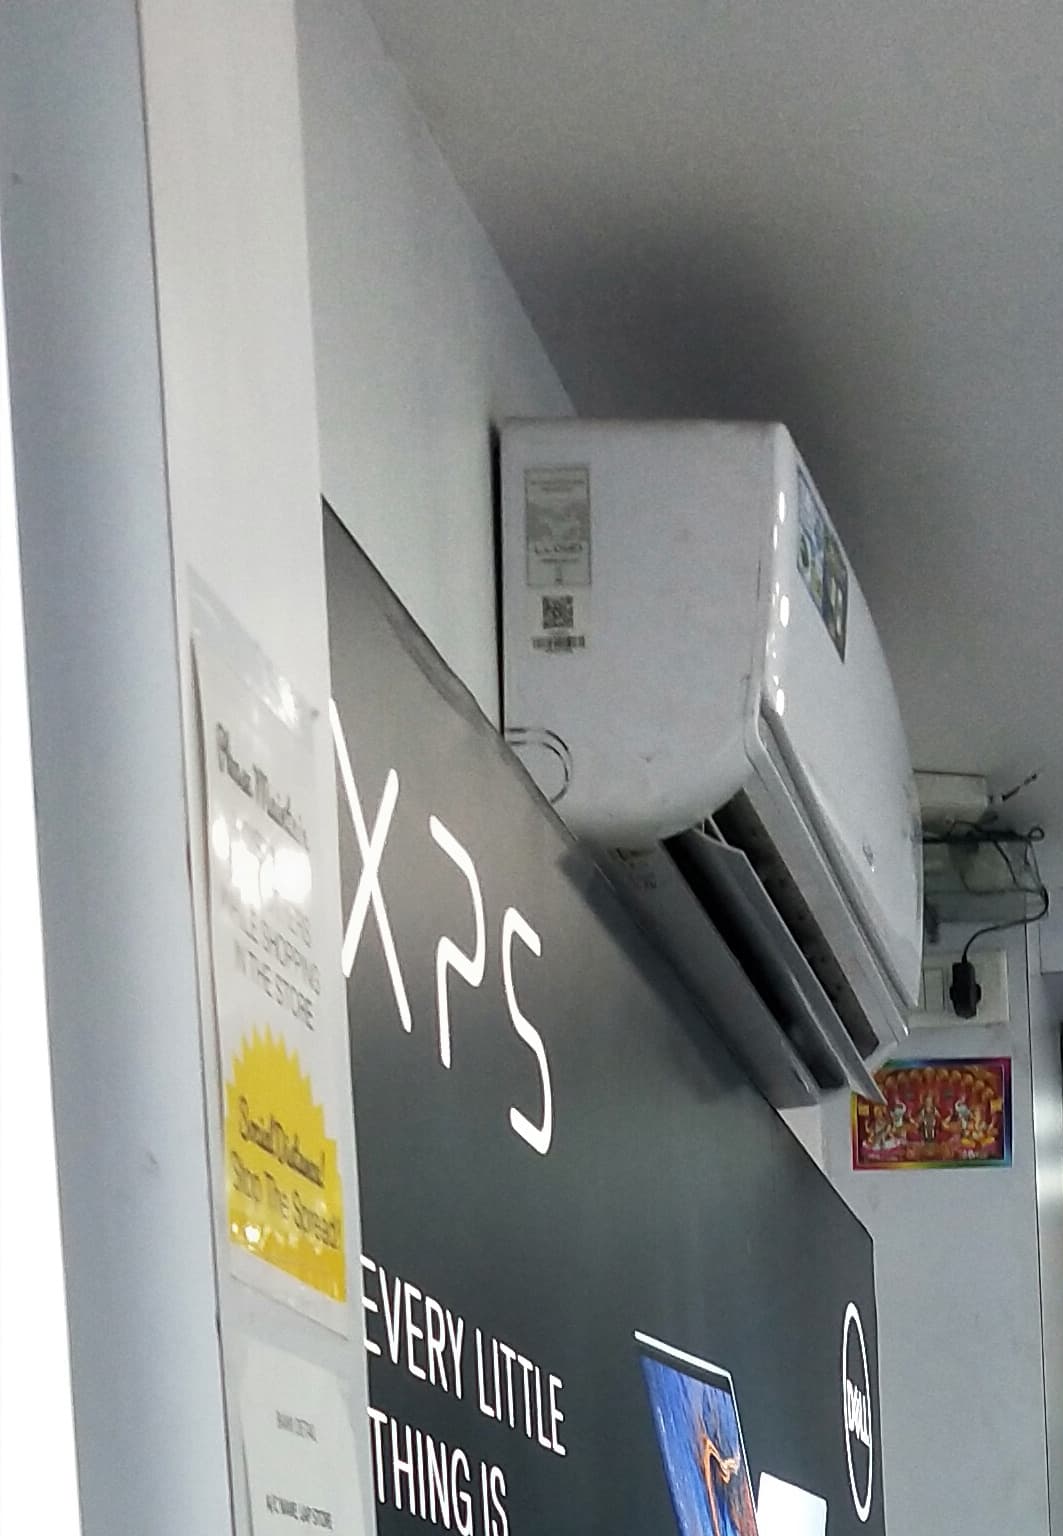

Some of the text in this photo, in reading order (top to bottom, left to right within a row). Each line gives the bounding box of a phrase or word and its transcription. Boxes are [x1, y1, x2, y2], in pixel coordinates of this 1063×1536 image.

[329, 697, 553, 1156] XPS
[359, 1254, 567, 1457] EVERY LITTLE
